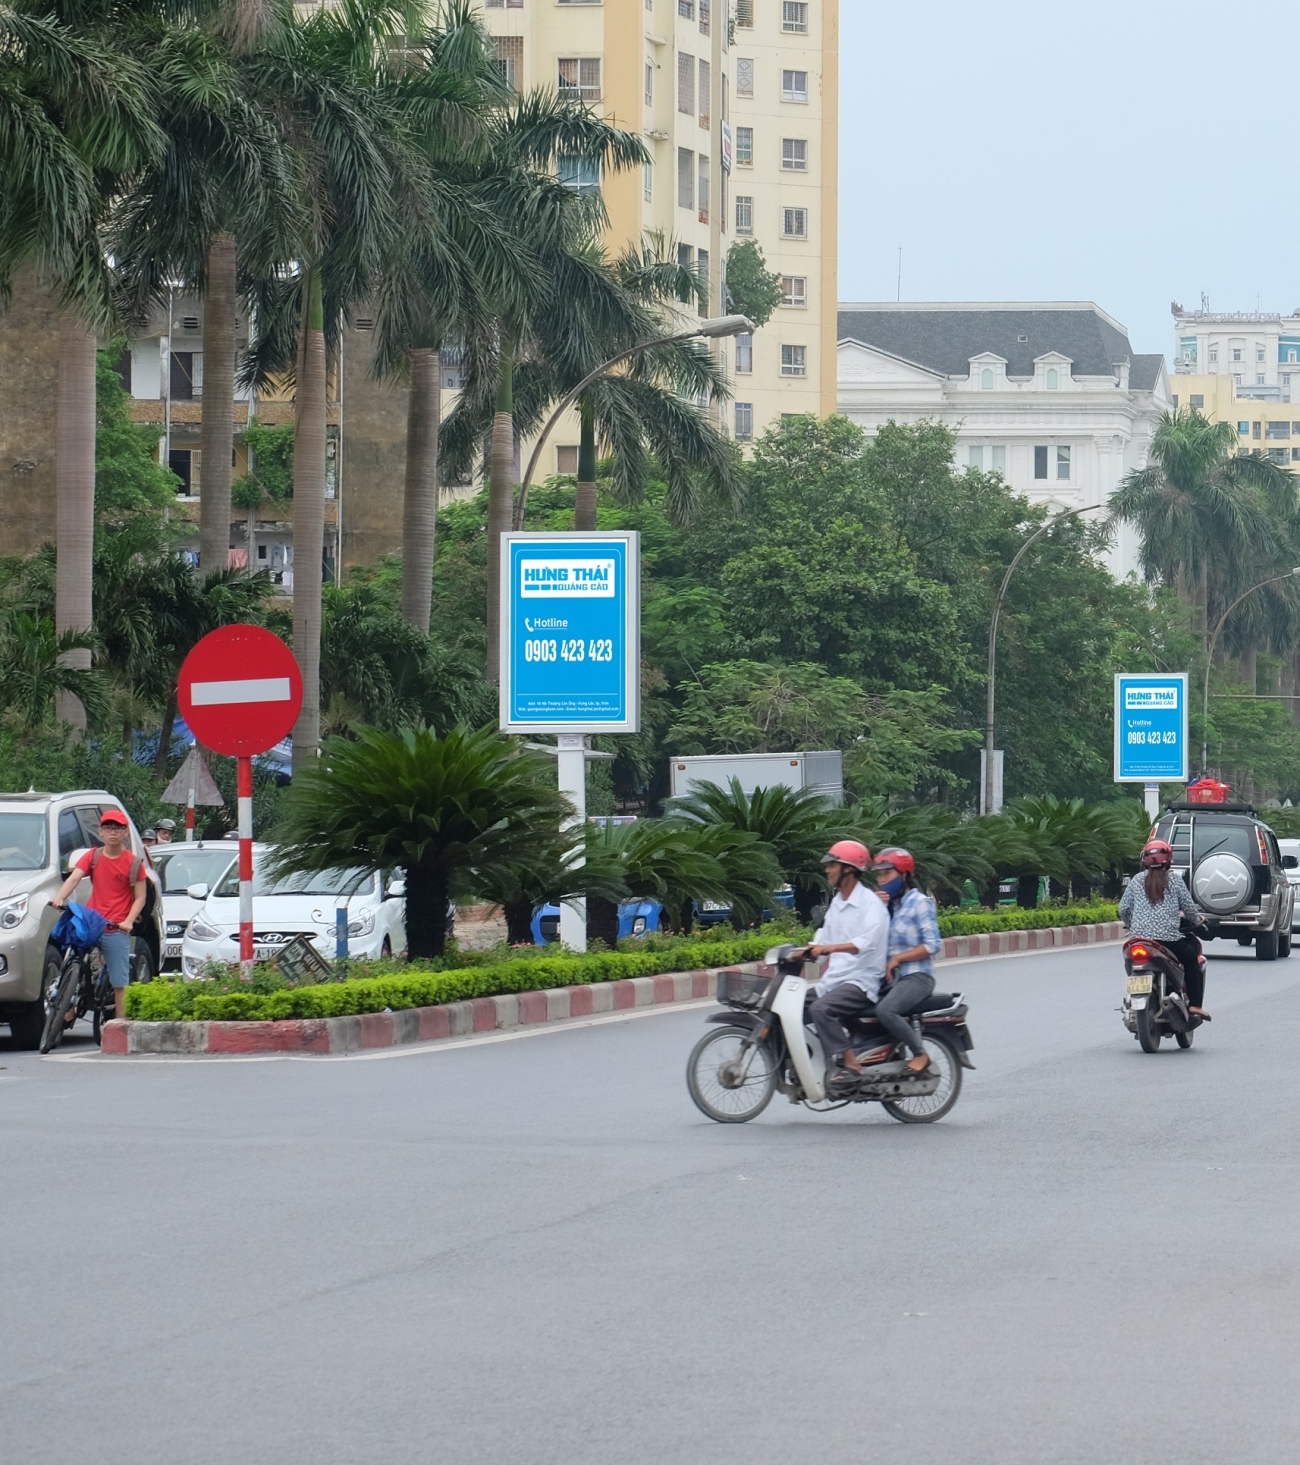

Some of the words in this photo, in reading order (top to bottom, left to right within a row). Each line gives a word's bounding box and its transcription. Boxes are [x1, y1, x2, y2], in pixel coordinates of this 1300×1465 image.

[525, 567, 568, 581] HƯNG
[573, 565, 608, 581] THÁI
[558, 582, 588, 590] QUẢNG
[591, 582, 608, 590] CÁO
[534, 618, 568, 627] Hotline
[525, 639, 557, 662] 0903
[561, 639, 585, 662] 423
[589, 639, 612, 662] 423
[1154, 691, 1173, 700] THÁI
[1128, 731, 1145, 744] 0903
[1147, 731, 1160, 744] 423
[1163, 731, 1176, 744] 423
